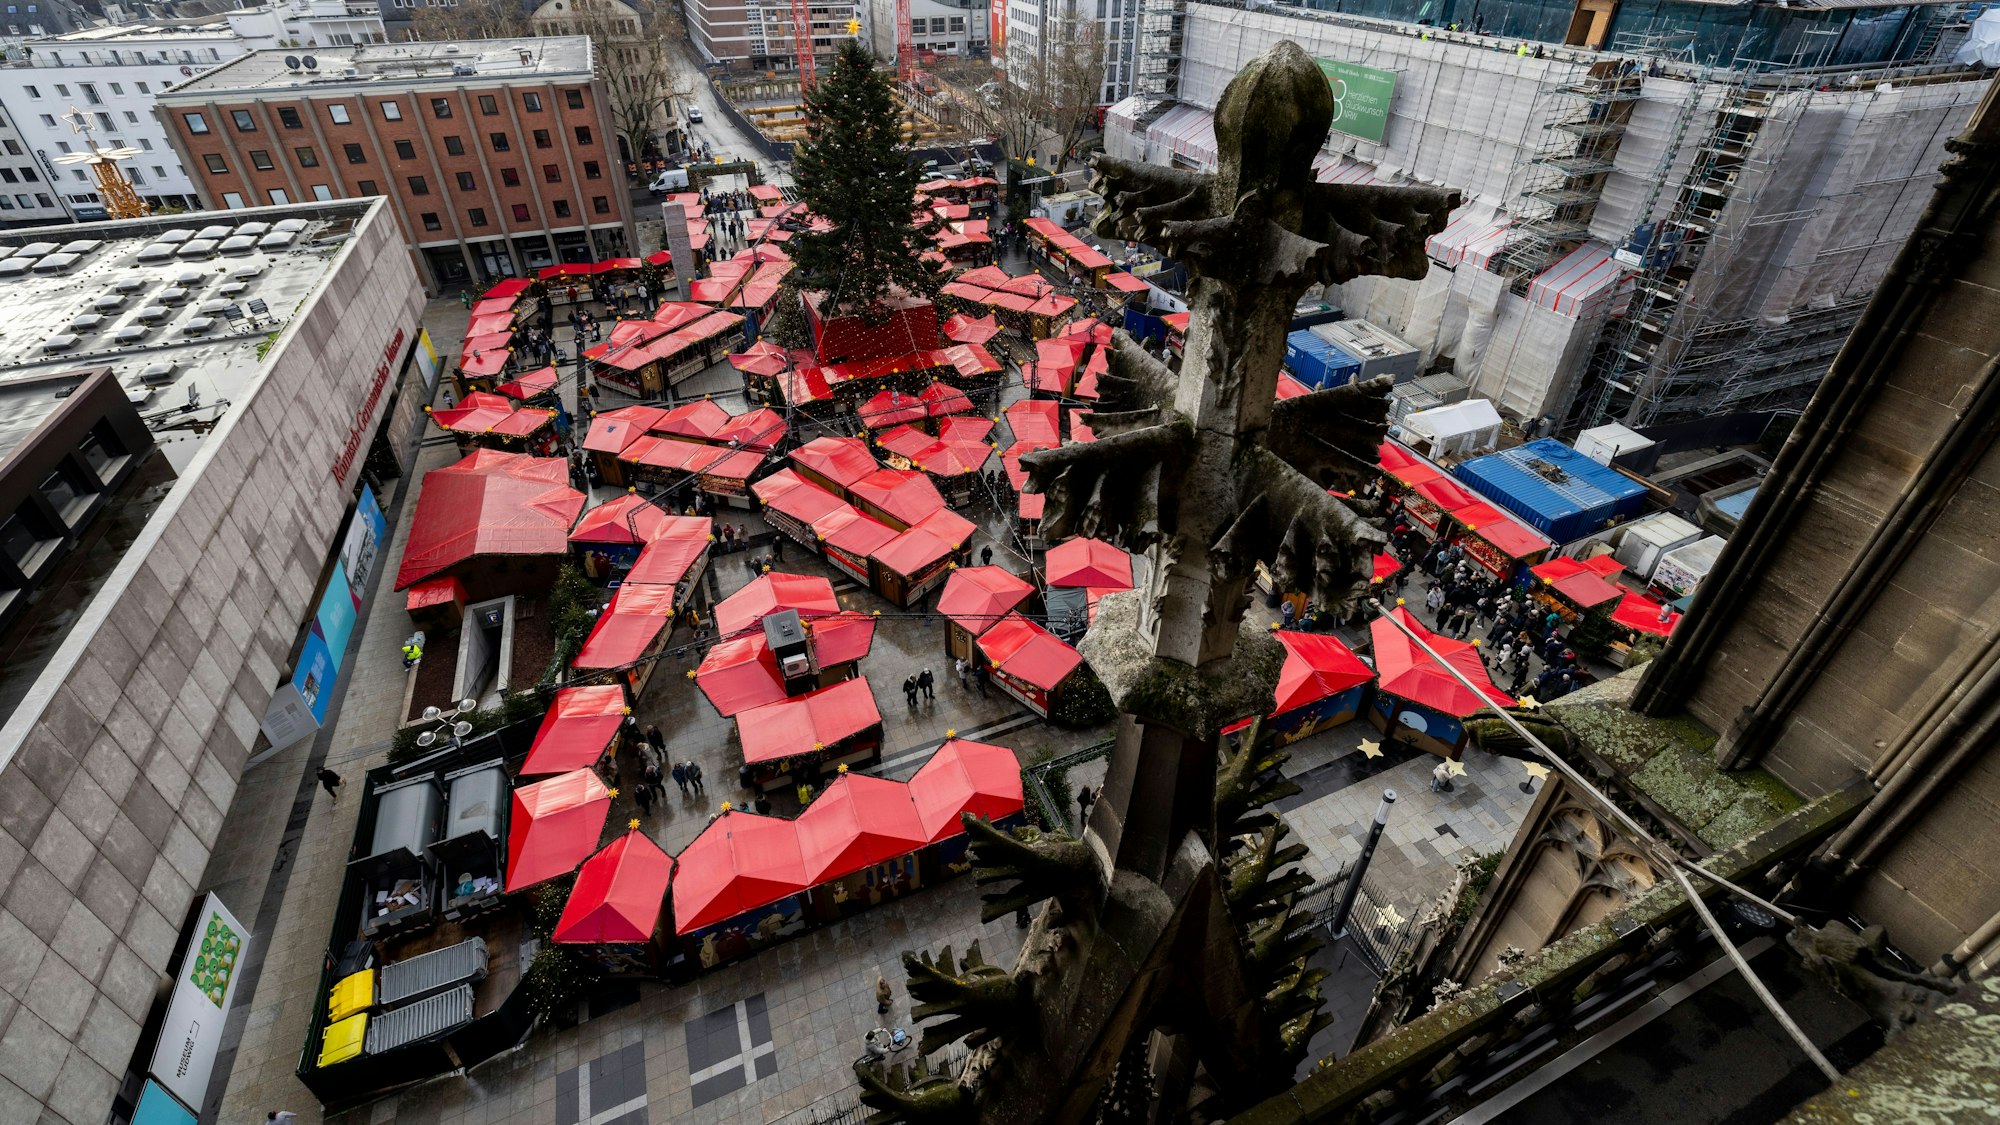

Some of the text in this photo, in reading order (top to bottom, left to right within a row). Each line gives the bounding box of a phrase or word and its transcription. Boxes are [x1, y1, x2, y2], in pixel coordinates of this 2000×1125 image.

[1343, 110, 1358, 120] NRW
[384, 327, 404, 369] Museum
[176, 1037, 191, 1078] MUSEUM
[182, 1041, 195, 1076] LUDWIG
